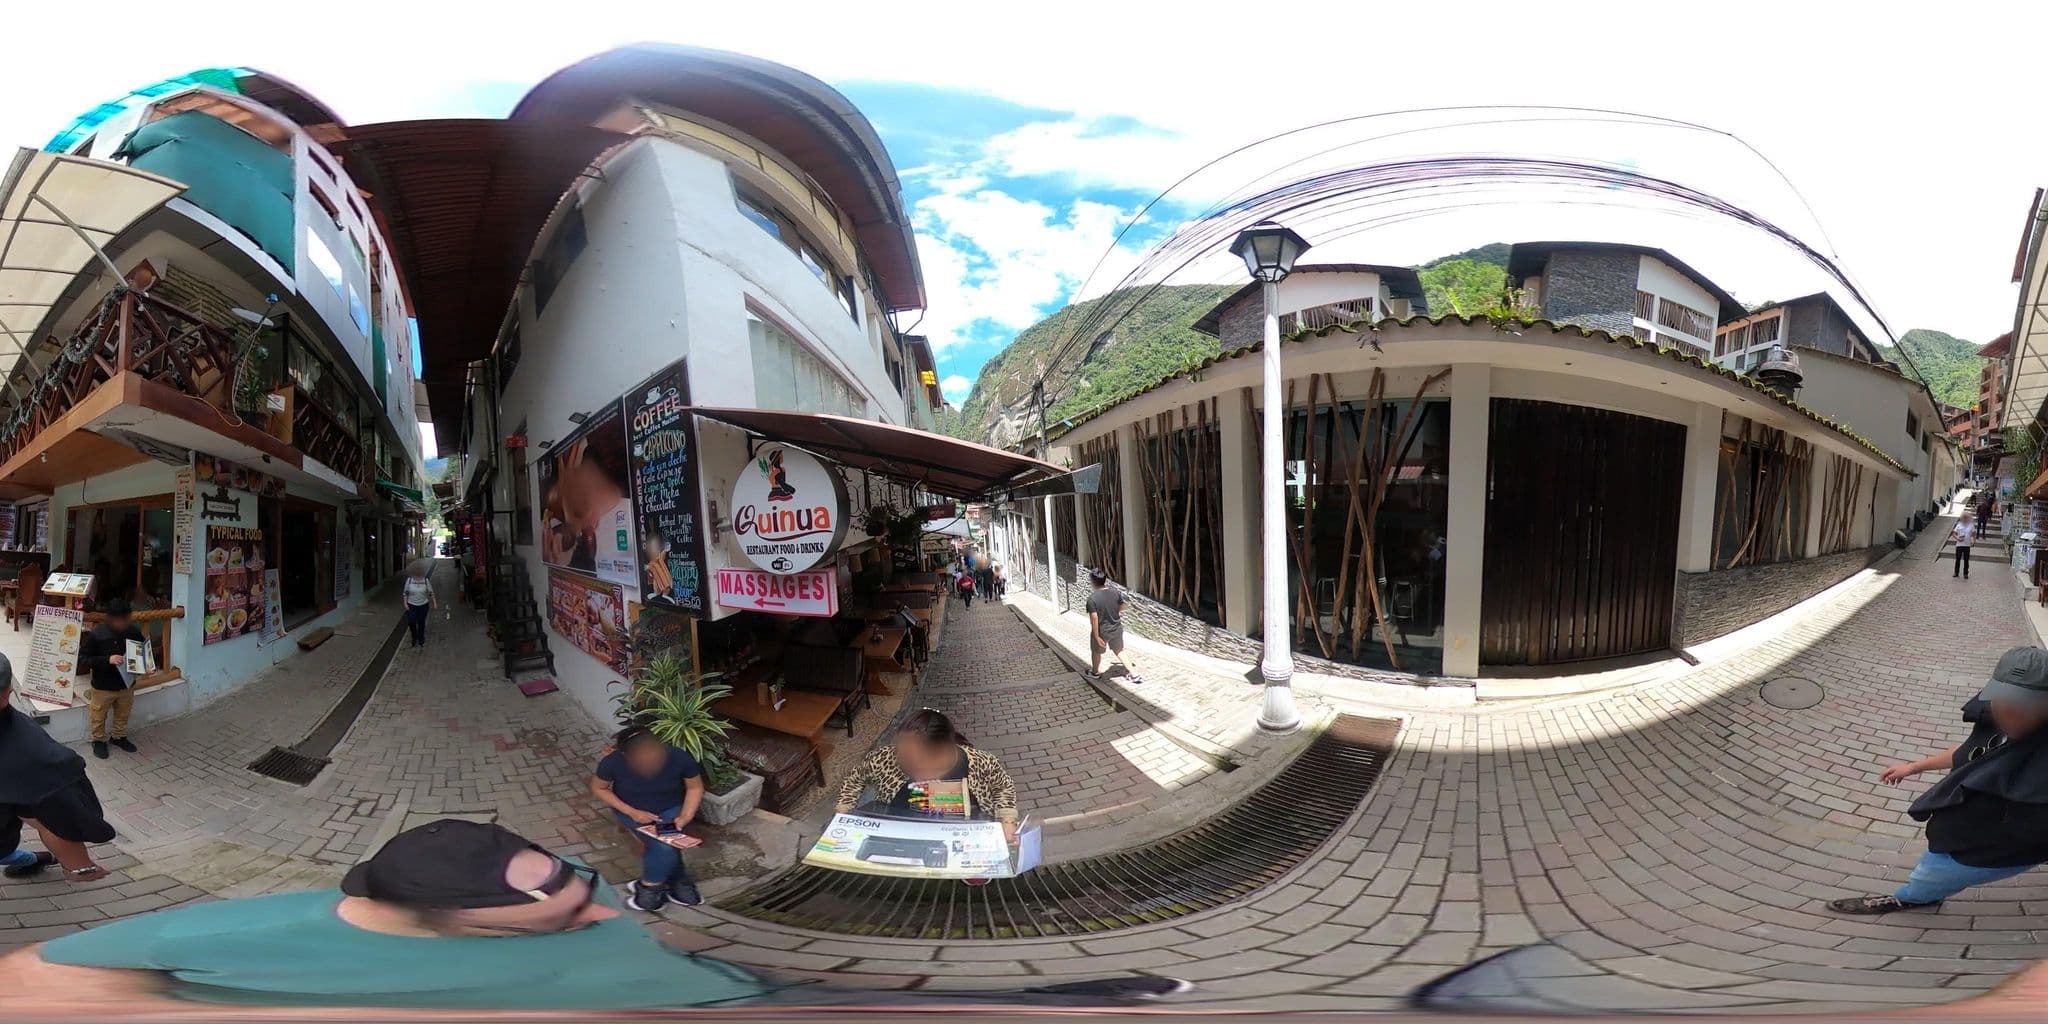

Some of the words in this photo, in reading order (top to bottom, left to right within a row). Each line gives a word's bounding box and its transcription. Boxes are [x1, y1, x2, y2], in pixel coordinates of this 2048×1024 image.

[633, 393, 681, 432] COFFEE
[636, 468, 647, 550] AMERICANO
[645, 498, 676, 513] Chocolate
[734, 504, 831, 537] Quinua
[211, 526, 243, 540] TYPICAL
[245, 528, 263, 541] FOOD
[746, 543, 779, 555] RESTAURANT
[780, 543, 796, 554] FOOD
[796, 544, 800, 554] &
[800, 542, 825, 553] DRINKS
[719, 573, 825, 600] MASSAGES
[37, 606, 54, 616] MENU
[54, 608, 82, 623] ESPECIAL
[838, 816, 881, 829] EPSON
